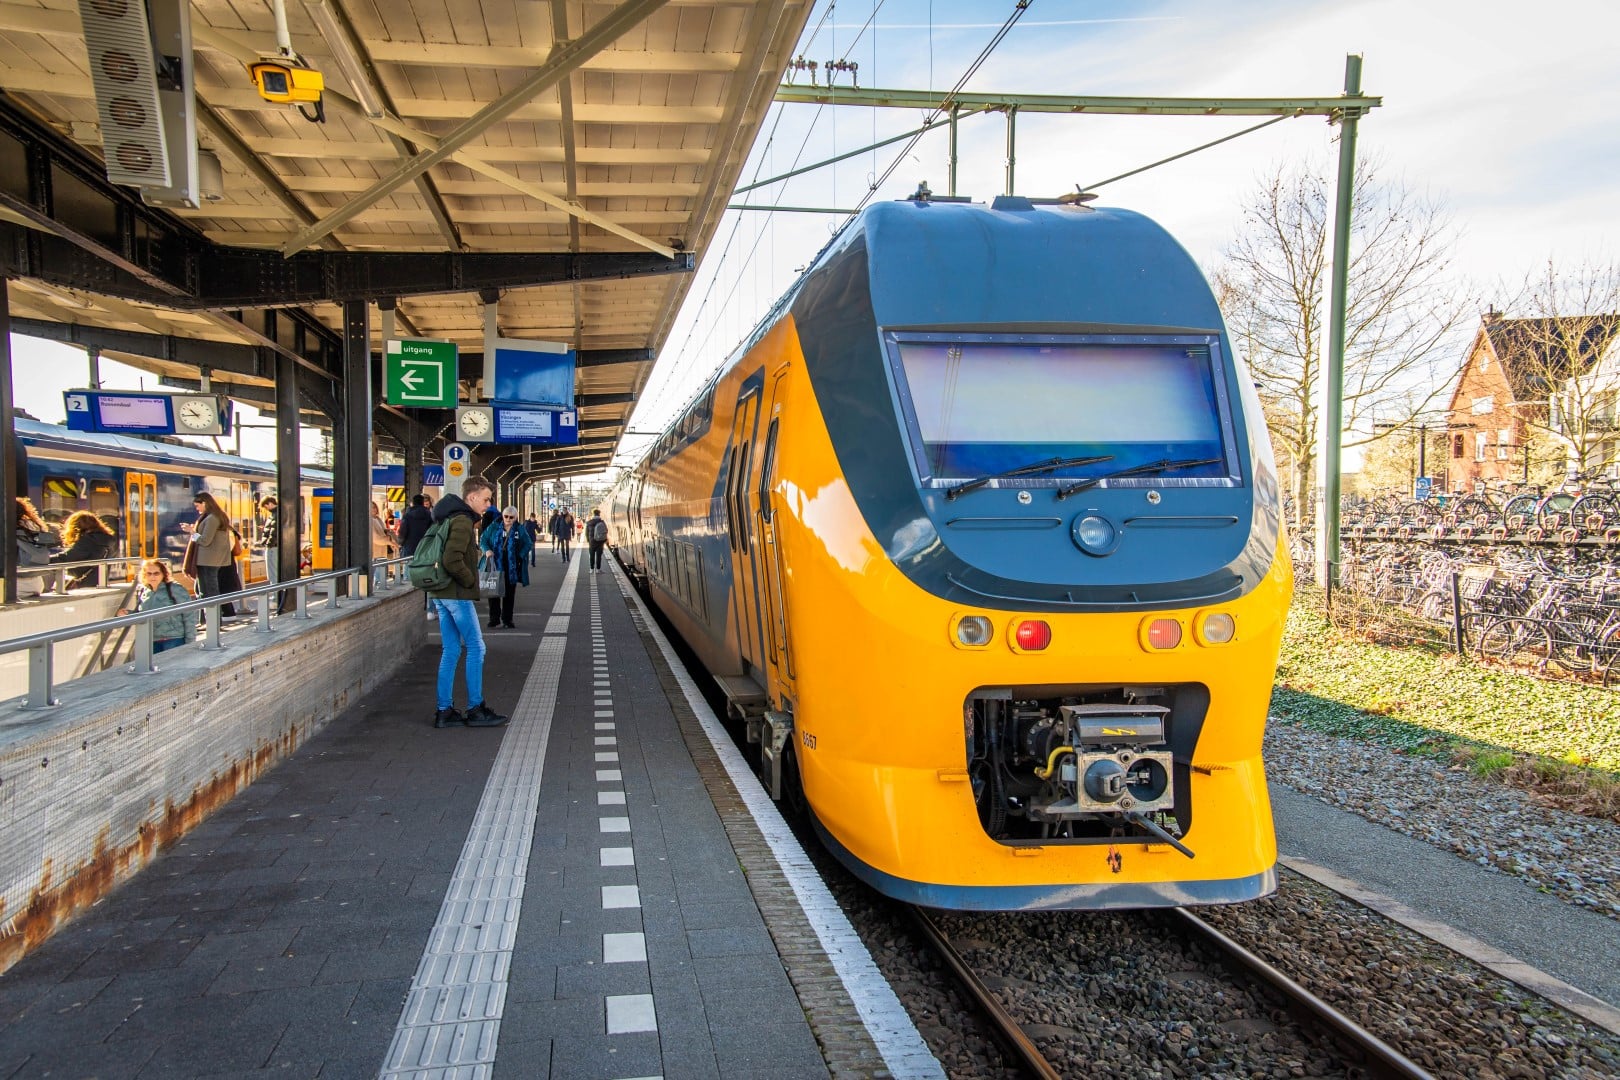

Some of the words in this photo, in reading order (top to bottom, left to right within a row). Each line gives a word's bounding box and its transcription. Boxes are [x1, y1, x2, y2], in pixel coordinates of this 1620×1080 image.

[402, 345, 433, 355] uitgang
[73, 400, 82, 410] 2
[564, 415, 570, 425] 1
[80, 477, 87, 499] 2
